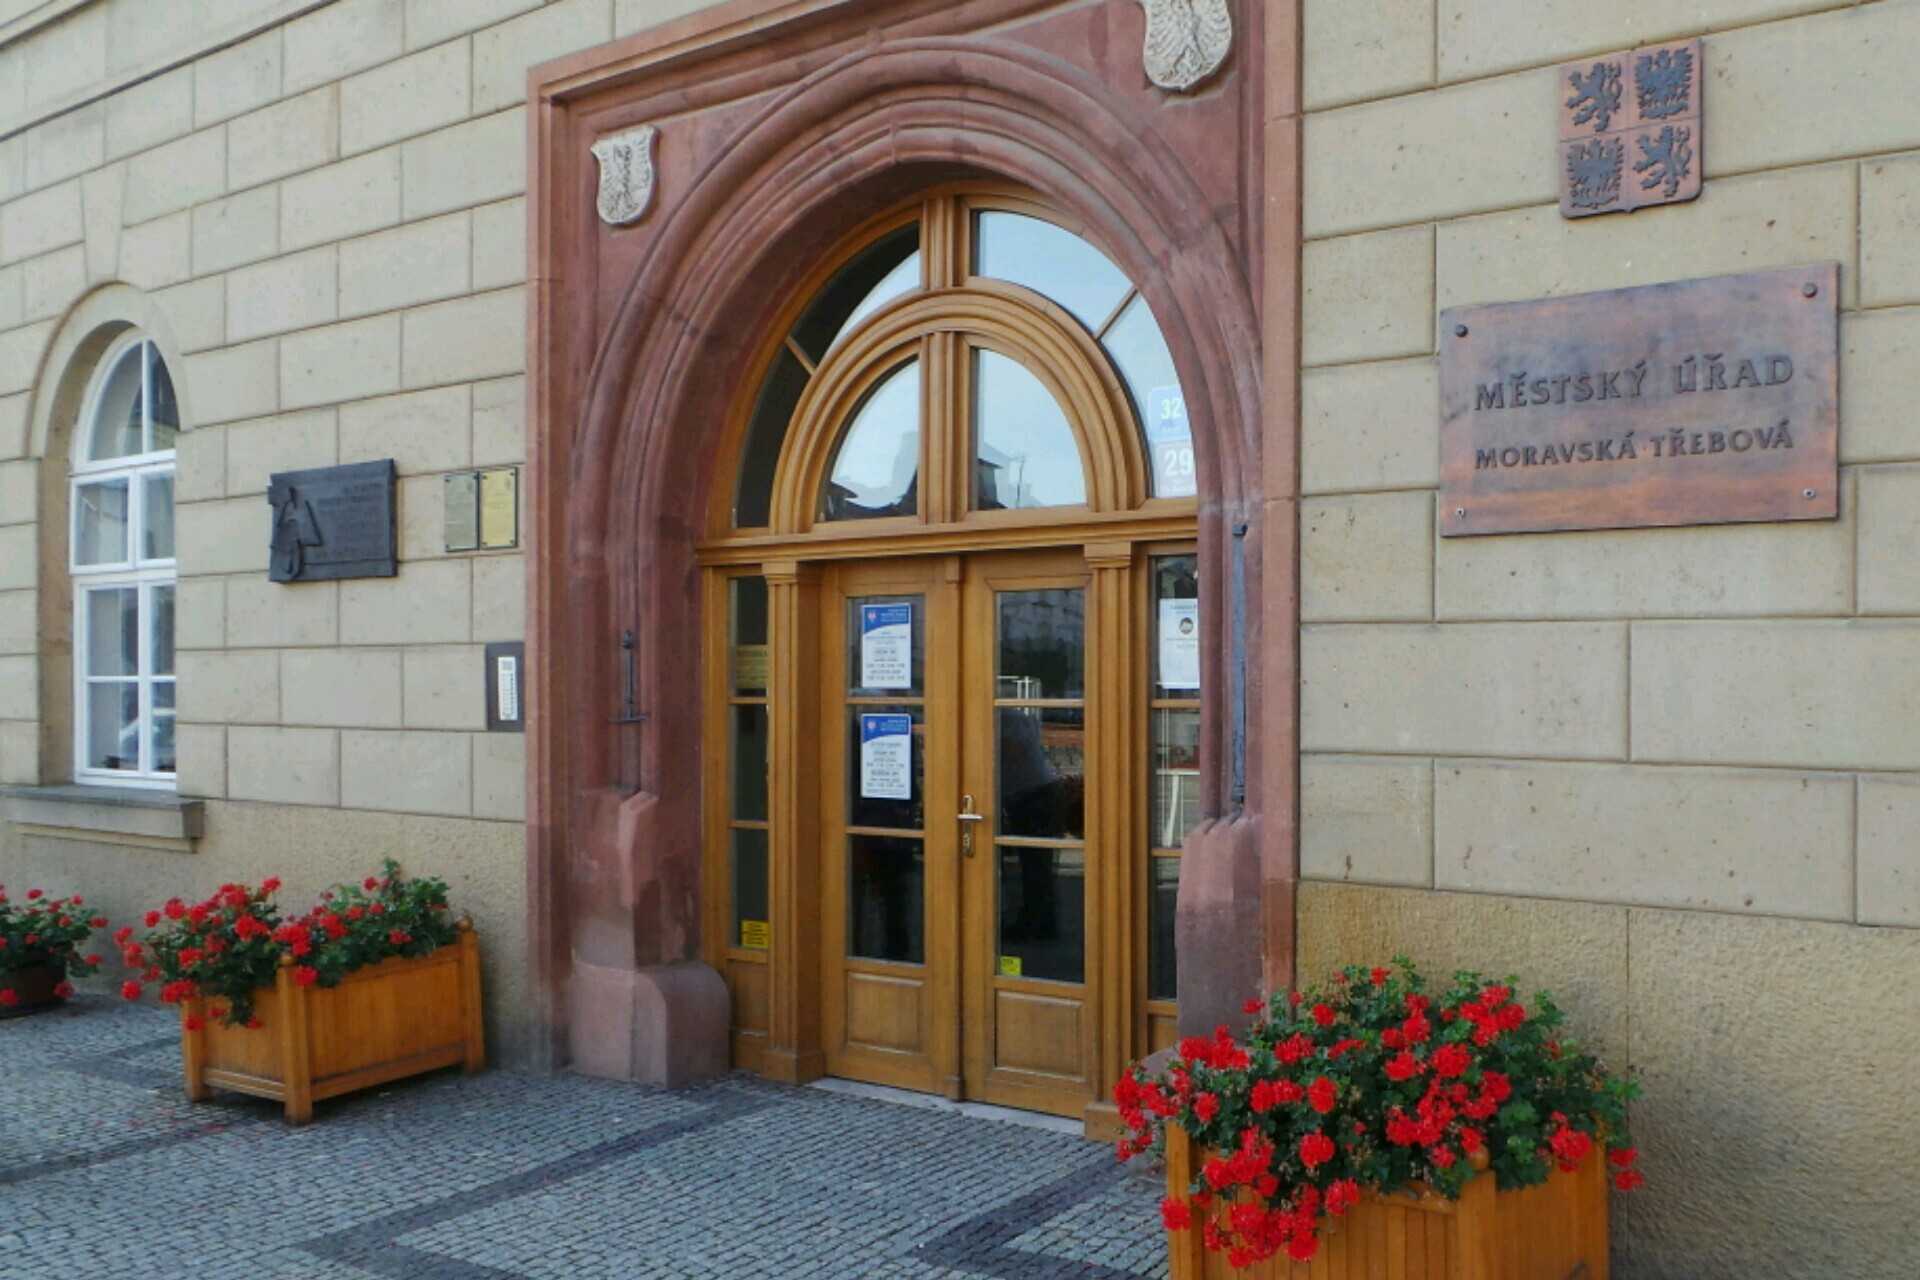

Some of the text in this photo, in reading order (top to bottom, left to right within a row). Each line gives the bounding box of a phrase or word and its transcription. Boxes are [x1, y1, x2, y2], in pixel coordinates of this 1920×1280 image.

[1474, 353, 1794, 411] MĚSTSKÝ ÚŘAD
[1160, 397, 1182, 420] 32
[1164, 448, 1193, 476] 29
[1474, 418, 1793, 469] MORAVSKÁ TŘEBOVÁ
